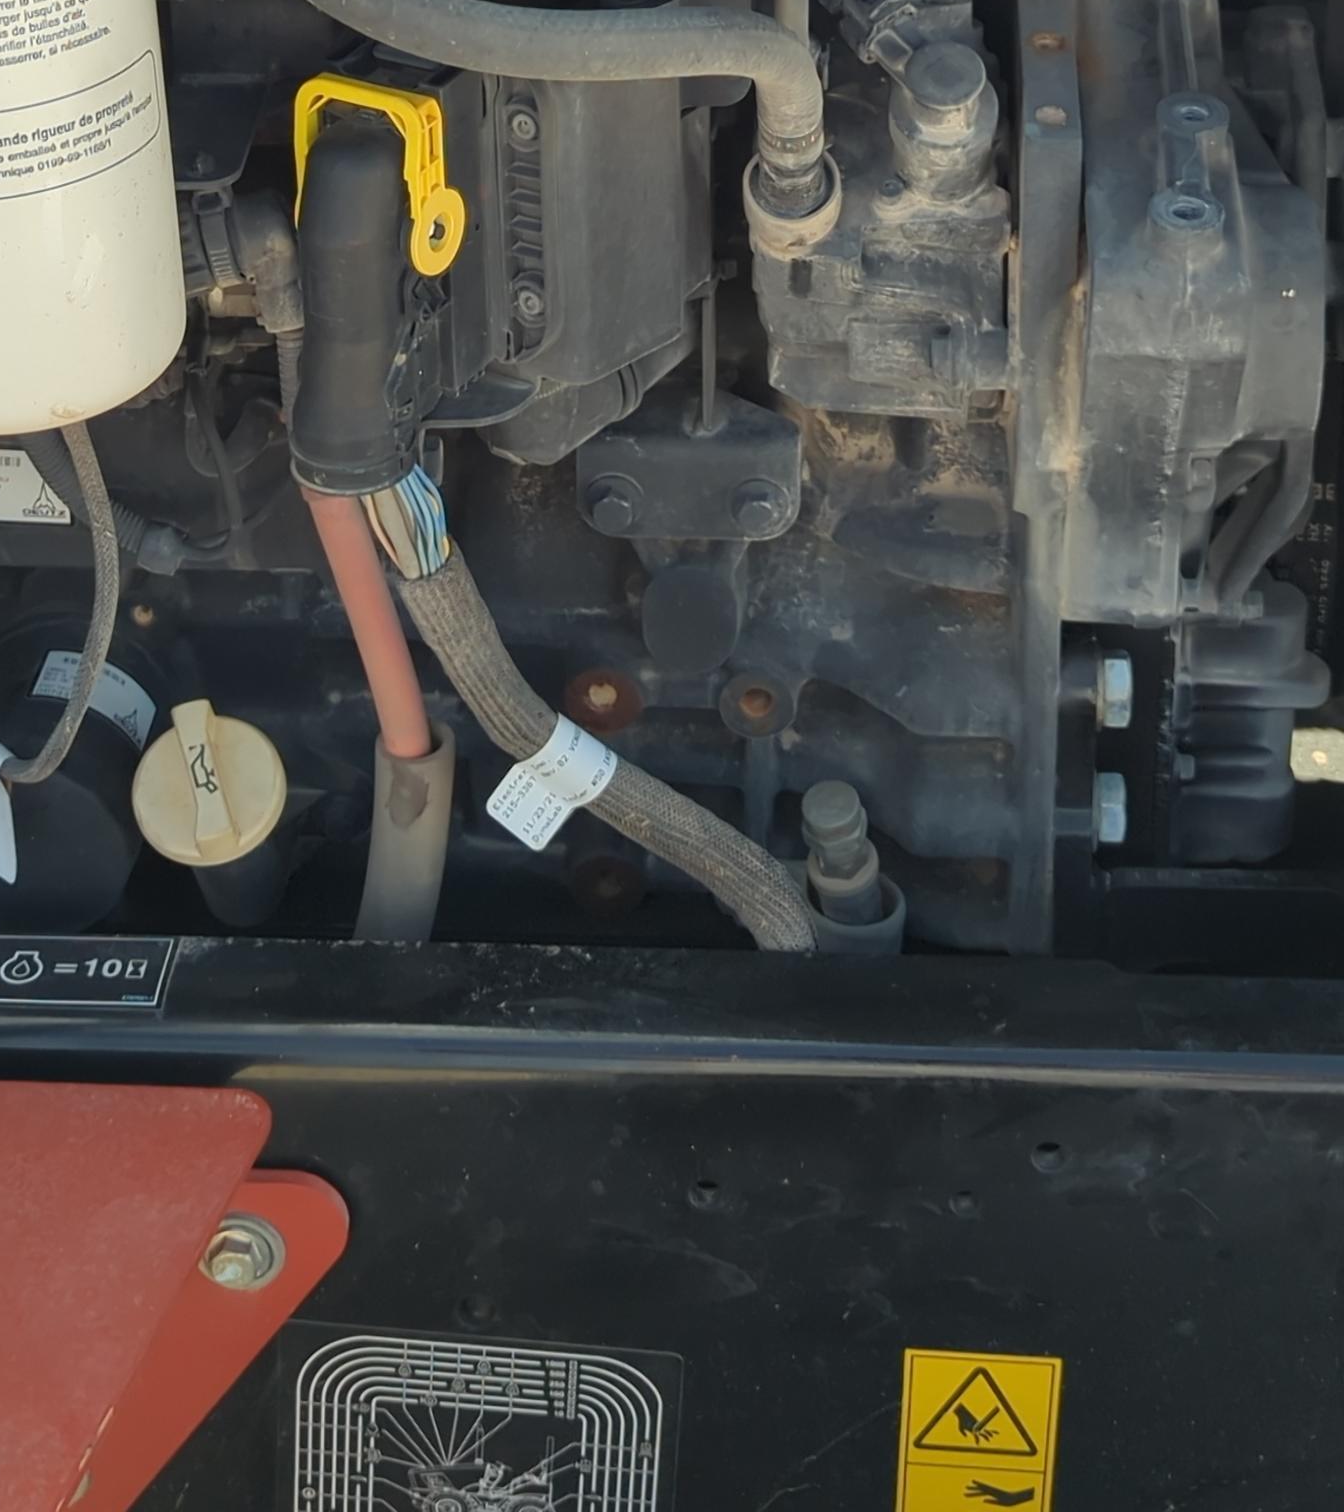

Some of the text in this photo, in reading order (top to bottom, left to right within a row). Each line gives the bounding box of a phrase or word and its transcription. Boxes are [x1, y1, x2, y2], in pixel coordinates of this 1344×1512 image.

[11, 25, 26, 37] de
[29, 19, 61, 33] bulles
[31, 119, 76, 146] rigueur
[79, 114, 94, 128] de
[95, 90, 135, 125] propreté
[72, 127, 103, 149] propre
